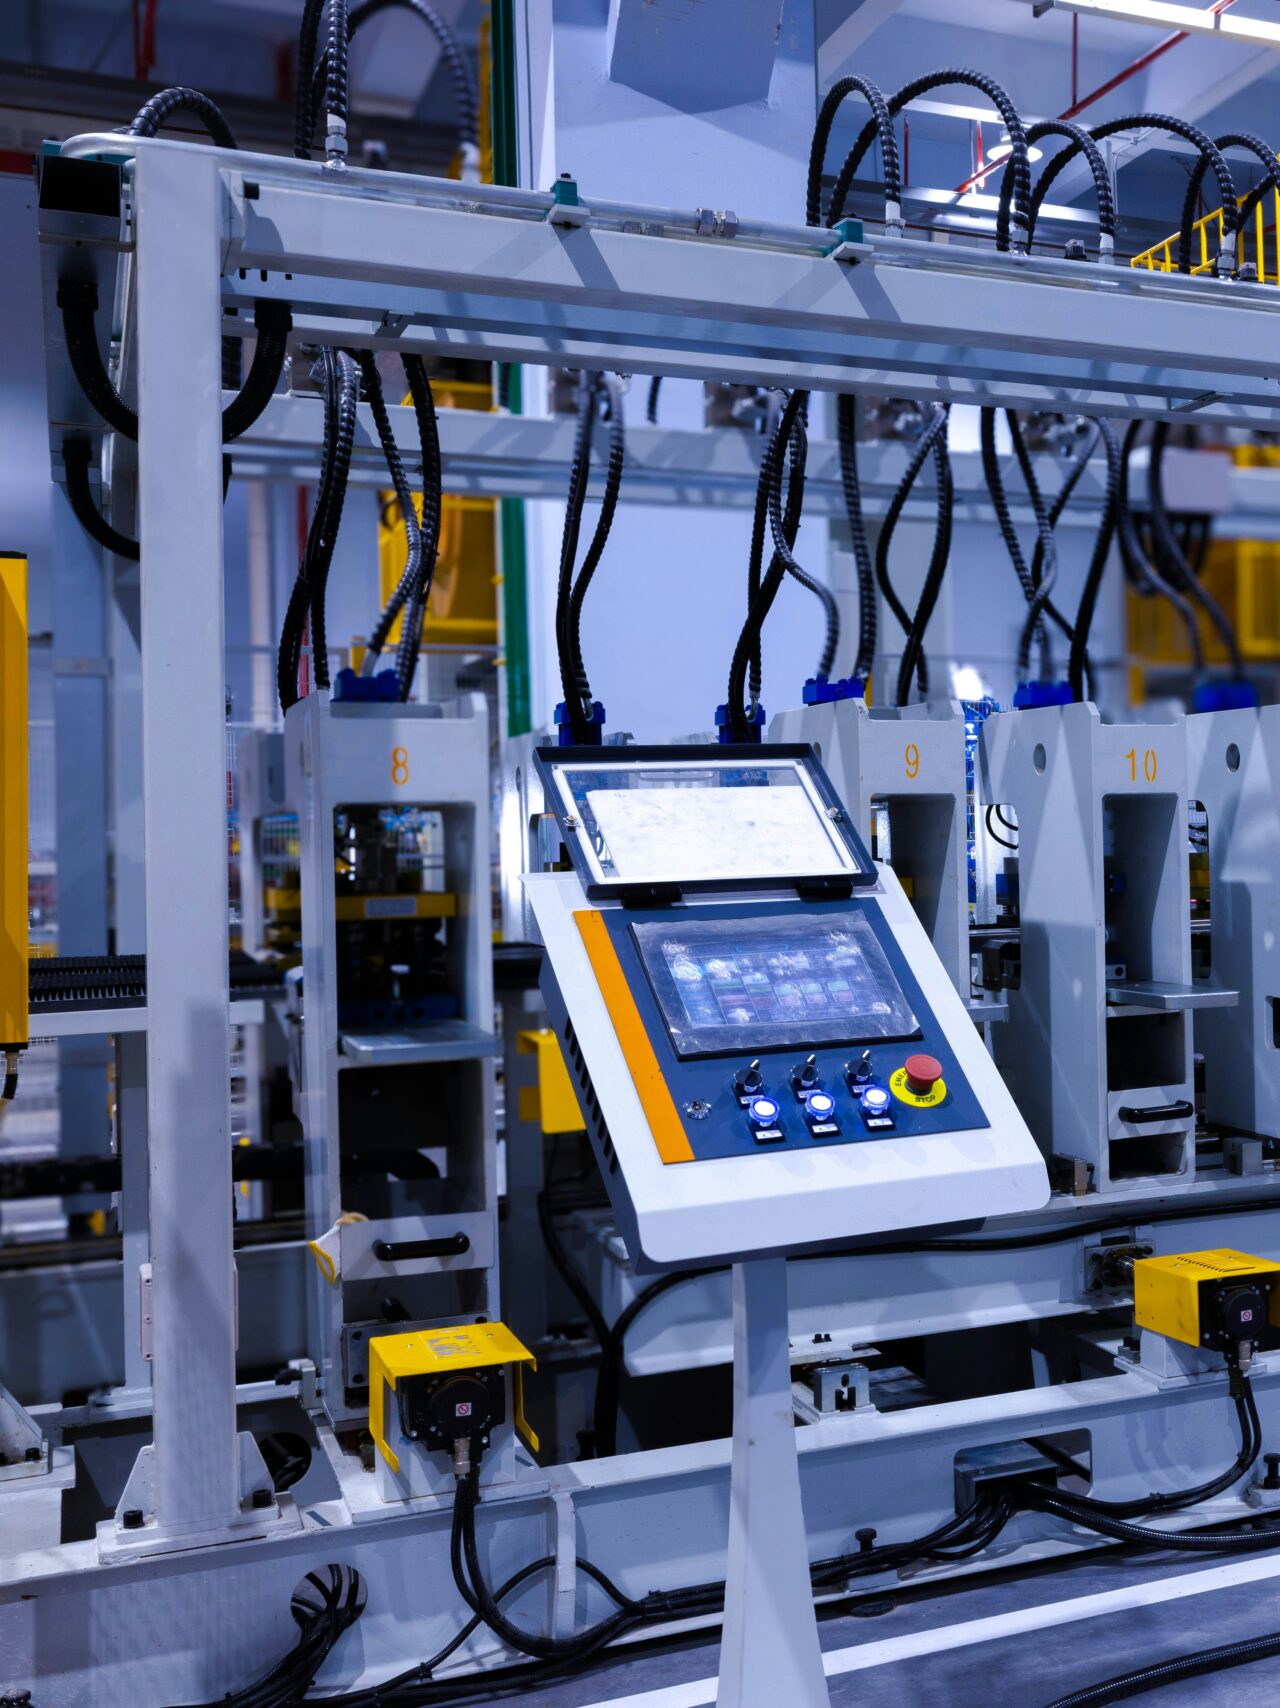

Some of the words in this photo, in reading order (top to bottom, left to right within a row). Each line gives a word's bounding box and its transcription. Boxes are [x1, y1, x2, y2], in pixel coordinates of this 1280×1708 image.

[391, 747, 410, 785] 8
[905, 743, 919, 779] 9
[1125, 747, 1157, 782] 10
[914, 1094, 936, 1103] STOP
